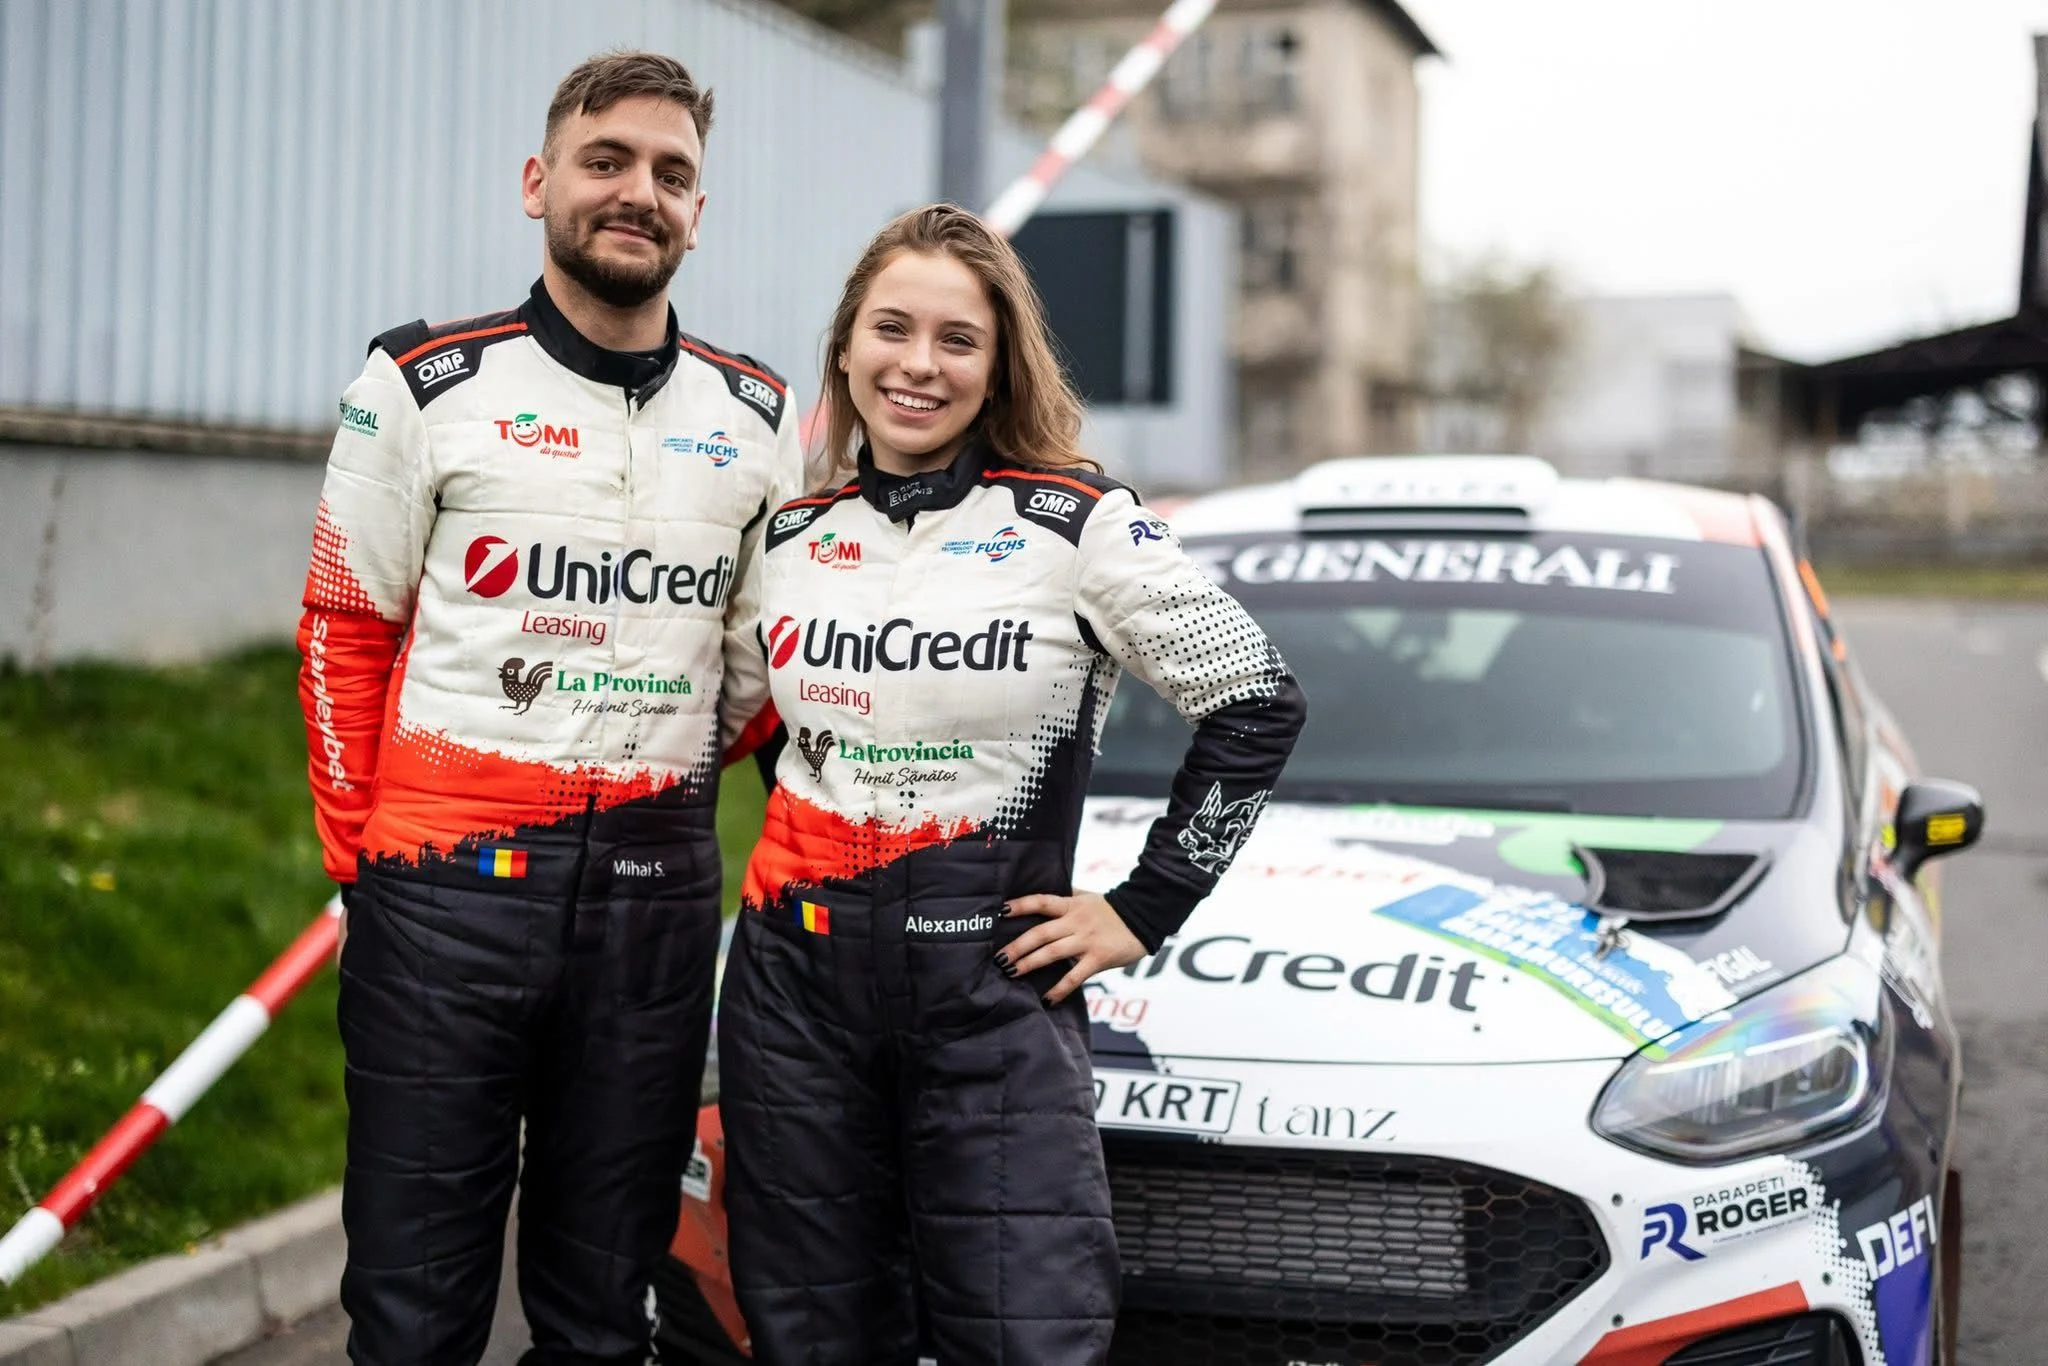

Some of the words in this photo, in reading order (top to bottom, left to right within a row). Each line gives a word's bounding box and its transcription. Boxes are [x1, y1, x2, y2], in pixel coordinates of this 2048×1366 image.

[418, 352, 465, 382] OMP
[739, 379, 778, 408] OMP
[494, 419, 579, 448] TOMI
[696, 442, 739, 459] FUCHS
[774, 509, 813, 529] OMP
[1029, 493, 1077, 515] OMP
[808, 541, 861, 563] TOMI
[975, 539, 1026, 554] FUCHS
[527, 542, 735, 609] UniCredit
[1232, 540, 1679, 594] GENERALI
[521, 610, 606, 645] Leasing
[802, 617, 1033, 673] UniCredit
[556, 670, 587, 692] La
[592, 671, 692, 695] Provincia
[800, 678, 871, 715] Leasing
[310, 613, 355, 792] stanleybet
[839, 738, 865, 762] La
[867, 739, 974, 764] Provincia
[853, 767, 895, 786] Hrnit
[612, 859, 652, 877] Mihai
[654, 861, 666, 877] S.
[905, 913, 993, 933] Alexandra
[1122, 935, 1485, 1012] iCredit
[1120, 1080, 1229, 1124] KRT
[1257, 1088, 1399, 1142] tanz
[1693, 1176, 1785, 1209] PARAPETI
[1696, 1186, 1809, 1236] ROGER
[1855, 1194, 1937, 1281] DEFI
